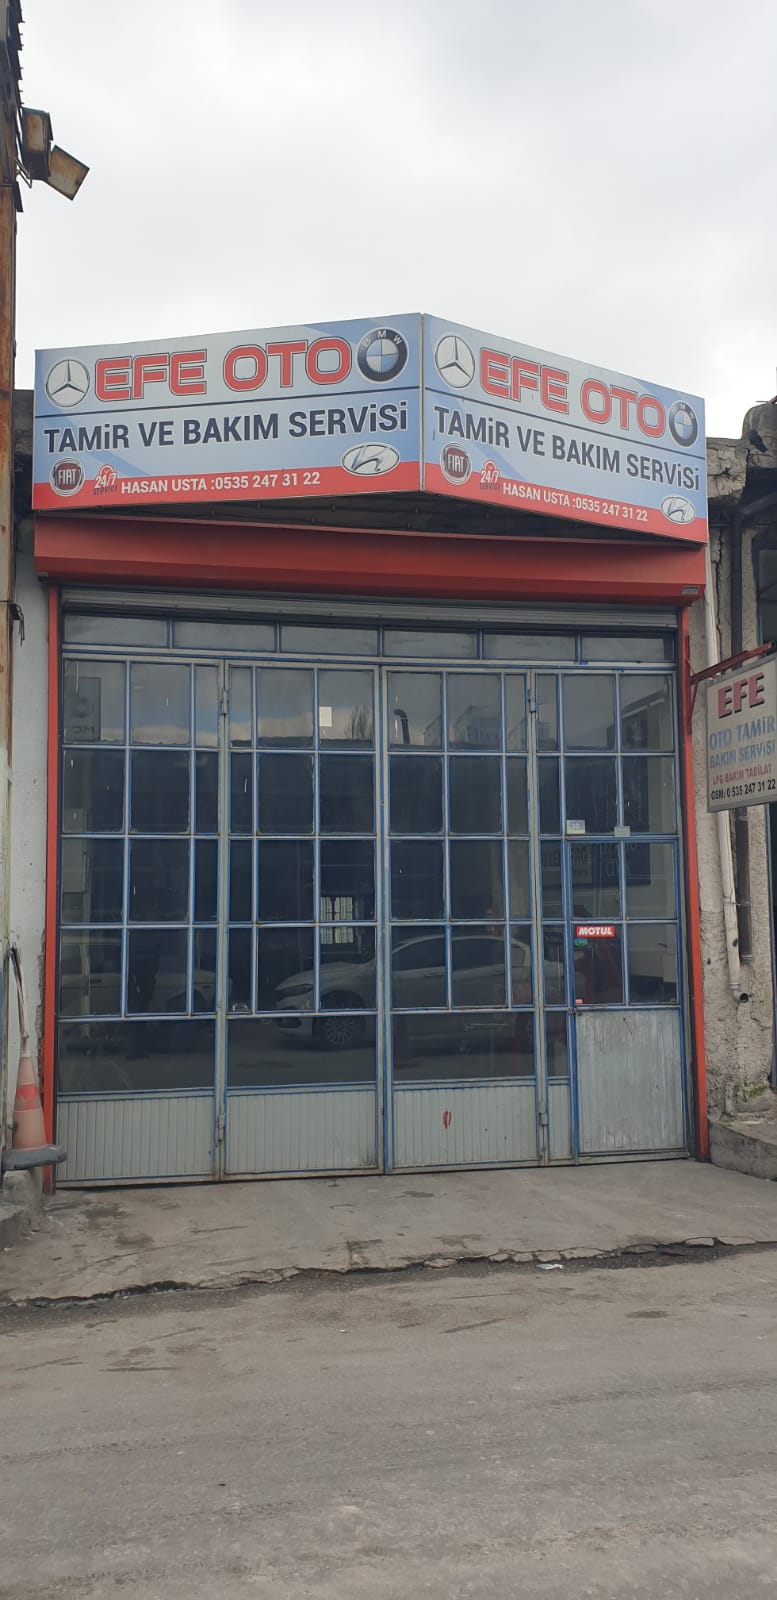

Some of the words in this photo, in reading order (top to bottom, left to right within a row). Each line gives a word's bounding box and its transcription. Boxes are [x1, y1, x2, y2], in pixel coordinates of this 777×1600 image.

[362, 329, 402, 347] BMW
[94, 348, 207, 402] EFE
[222, 336, 352, 392] OTO
[480, 347, 569, 415] EFE
[580, 378, 666, 438] OTO
[139, 420, 174, 447] VE
[183, 413, 279, 444] BAKIM
[516, 426, 545, 457] VE
[552, 435, 620, 474] BAKIM
[447, 453, 464, 473] FIAT
[58, 468, 77, 485] FIAT
[94, 472, 117, 488] 24/7
[121, 477, 168, 494] HASAN
[171, 474, 207, 491] USTA
[210, 474, 249, 490] :0535
[252, 472, 278, 488] 247
[281, 471, 299, 486] 31
[303, 470, 321, 485] 22
[479, 470, 500, 484] 24/7
[503, 483, 541, 501] HASAN
[544, 491, 570, 507] USTA
[572, 497, 600, 513] :0535
[602, 501, 620, 516] 247
[622, 505, 634, 519] 31
[636, 508, 648, 522] 22
[717, 672, 765, 719] EFE
[709, 729, 732, 750] OTO
[710, 750, 736, 769] BAKIM
[724, 768, 744, 783] BAKIM
[727, 787, 731, 797] 0
[732, 785, 743, 797] 535
[744, 782, 756, 794] 247
[757, 781, 765, 792] 31
[767, 778, 777, 790] 22
[578, 926, 612, 936] MOTUL
